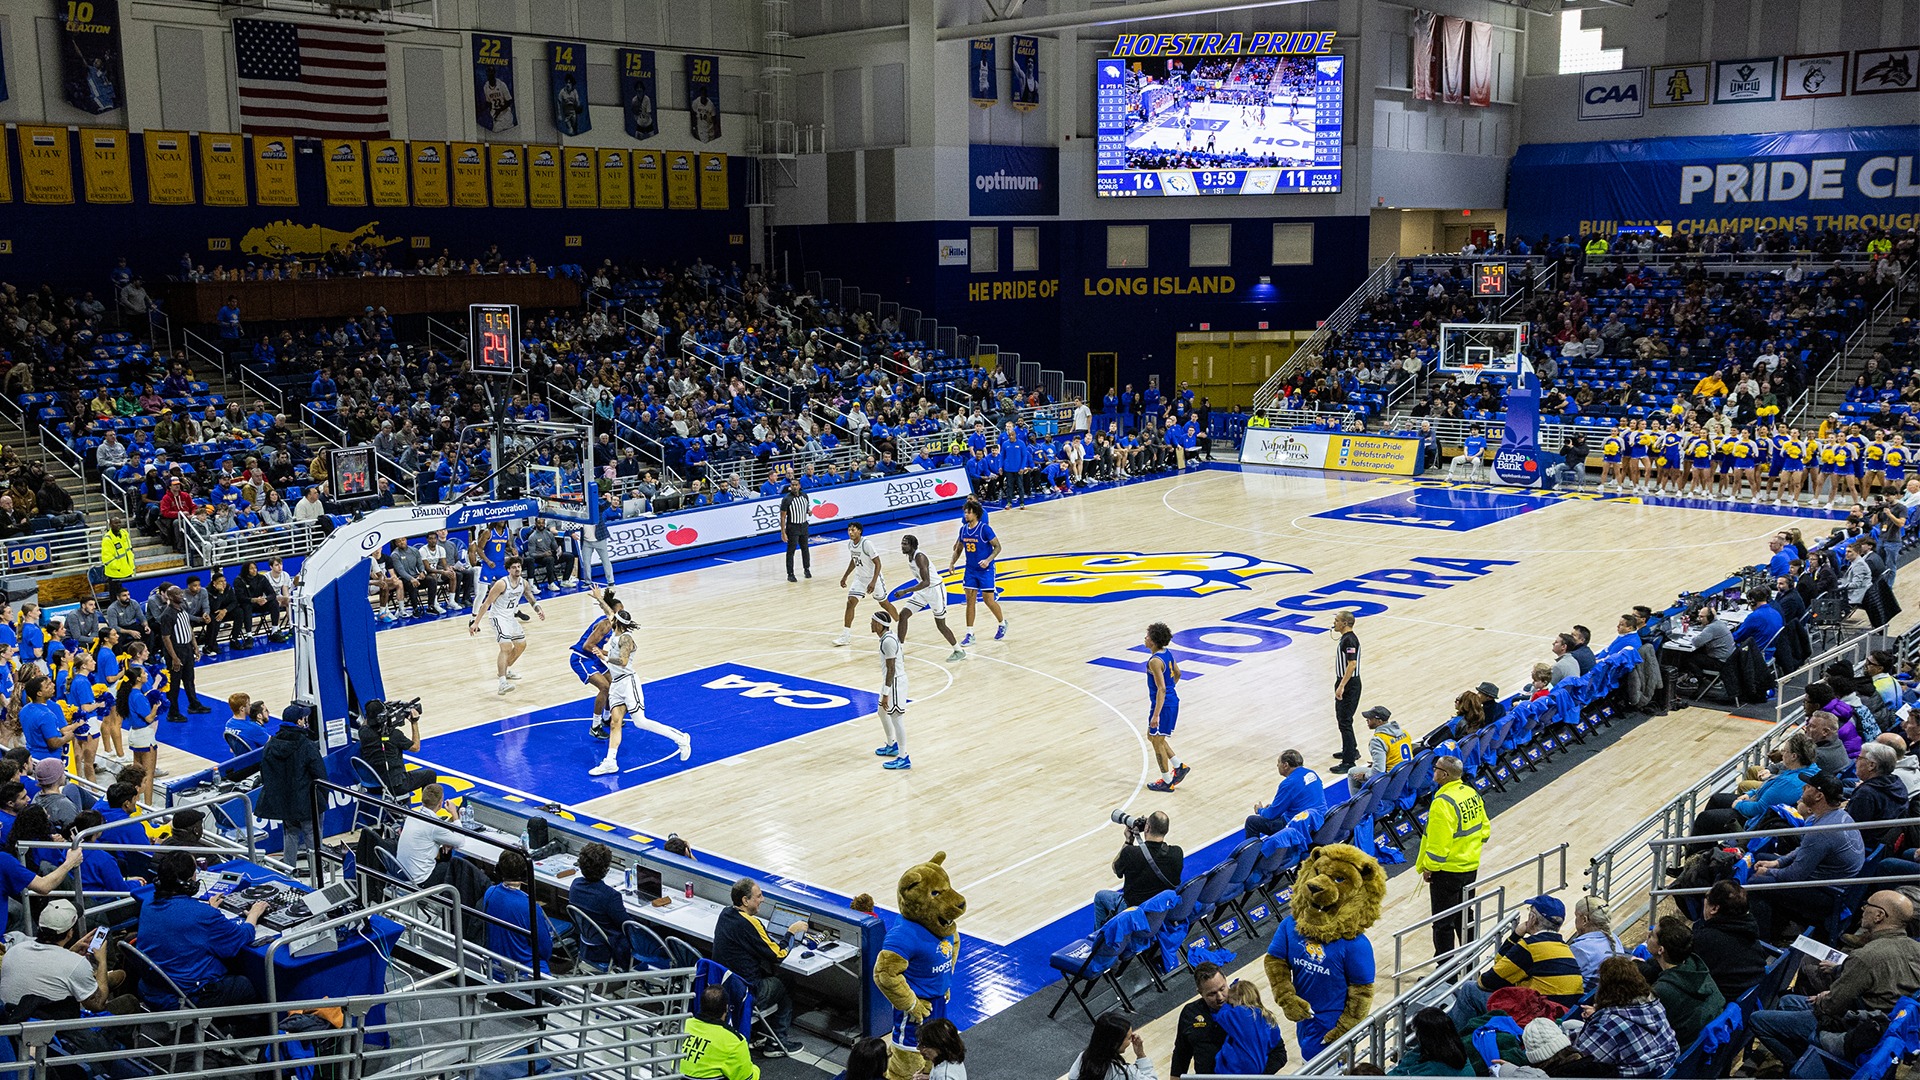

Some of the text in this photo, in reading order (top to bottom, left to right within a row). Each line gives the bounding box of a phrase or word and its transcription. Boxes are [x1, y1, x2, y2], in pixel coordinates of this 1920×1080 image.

[67, 1, 93, 22] 10
[66, 22, 110, 34] CLAXTON
[479, 39, 501, 57] 22
[1112, 31, 1337, 56] HOFSTRA PRIDE
[555, 47, 573, 63] 14
[1017, 47, 1036, 56] GALLO
[476, 56, 509, 67] JENKINS
[555, 63, 577, 72] IRWIN
[625, 53, 642, 70] 15
[692, 60, 711, 75] 30
[1730, 81, 1760, 92] UNCW
[1585, 84, 1639, 104] CAA
[29, 150, 61, 158] AIAW
[95, 152, 117, 160] NIT
[155, 153, 182, 161] NCAA
[211, 155, 236, 164] NCAA
[266, 163, 285, 171] NIT
[458, 168, 481, 176] WNIT
[1133, 174, 1154, 189] 16
[1202, 172, 1236, 186] 9:59
[1286, 171, 1305, 186] 11
[1679, 157, 1847, 205] PRIDE
[1677, 216, 1808, 234] CHAMPIONS
[212, 240, 226, 249] 110
[414, 239, 426, 248] 111
[993, 280, 1037, 301] PRIDE
[1040, 279, 1060, 298] OF
[1084, 276, 1236, 296] LONG ISLAND
[1480, 276, 1500, 293] 24
[484, 332, 508, 364] 24
[927, 441, 942, 452] 112
[1354, 441, 1381, 450] Hofstra
[1353, 450, 1404, 460] @HofstraPride
[1497, 452, 1525, 462] Apple
[1351, 460, 1395, 469] hofstrapride
[1497, 461, 1522, 470] Bank
[343, 472, 364, 491] 24
[884, 478, 934, 496] Apple
[885, 490, 932, 507] Bank
[412, 506, 450, 518] SPALDING
[472, 509, 484, 518] 2M
[485, 503, 528, 516] Corporation
[1345, 513, 1455, 527] CAA
[496, 544, 501, 552] 0
[607, 538, 663, 558] Bank
[966, 543, 976, 552] 33
[11, 546, 48, 566] 108
[507, 600, 516, 609] 15
[1087, 557, 1520, 680] HOFSTRA
[701, 674, 850, 708] CAA
[1401, 744, 1411, 761] 9
[1293, 957, 1330, 976] HOFSTRA
